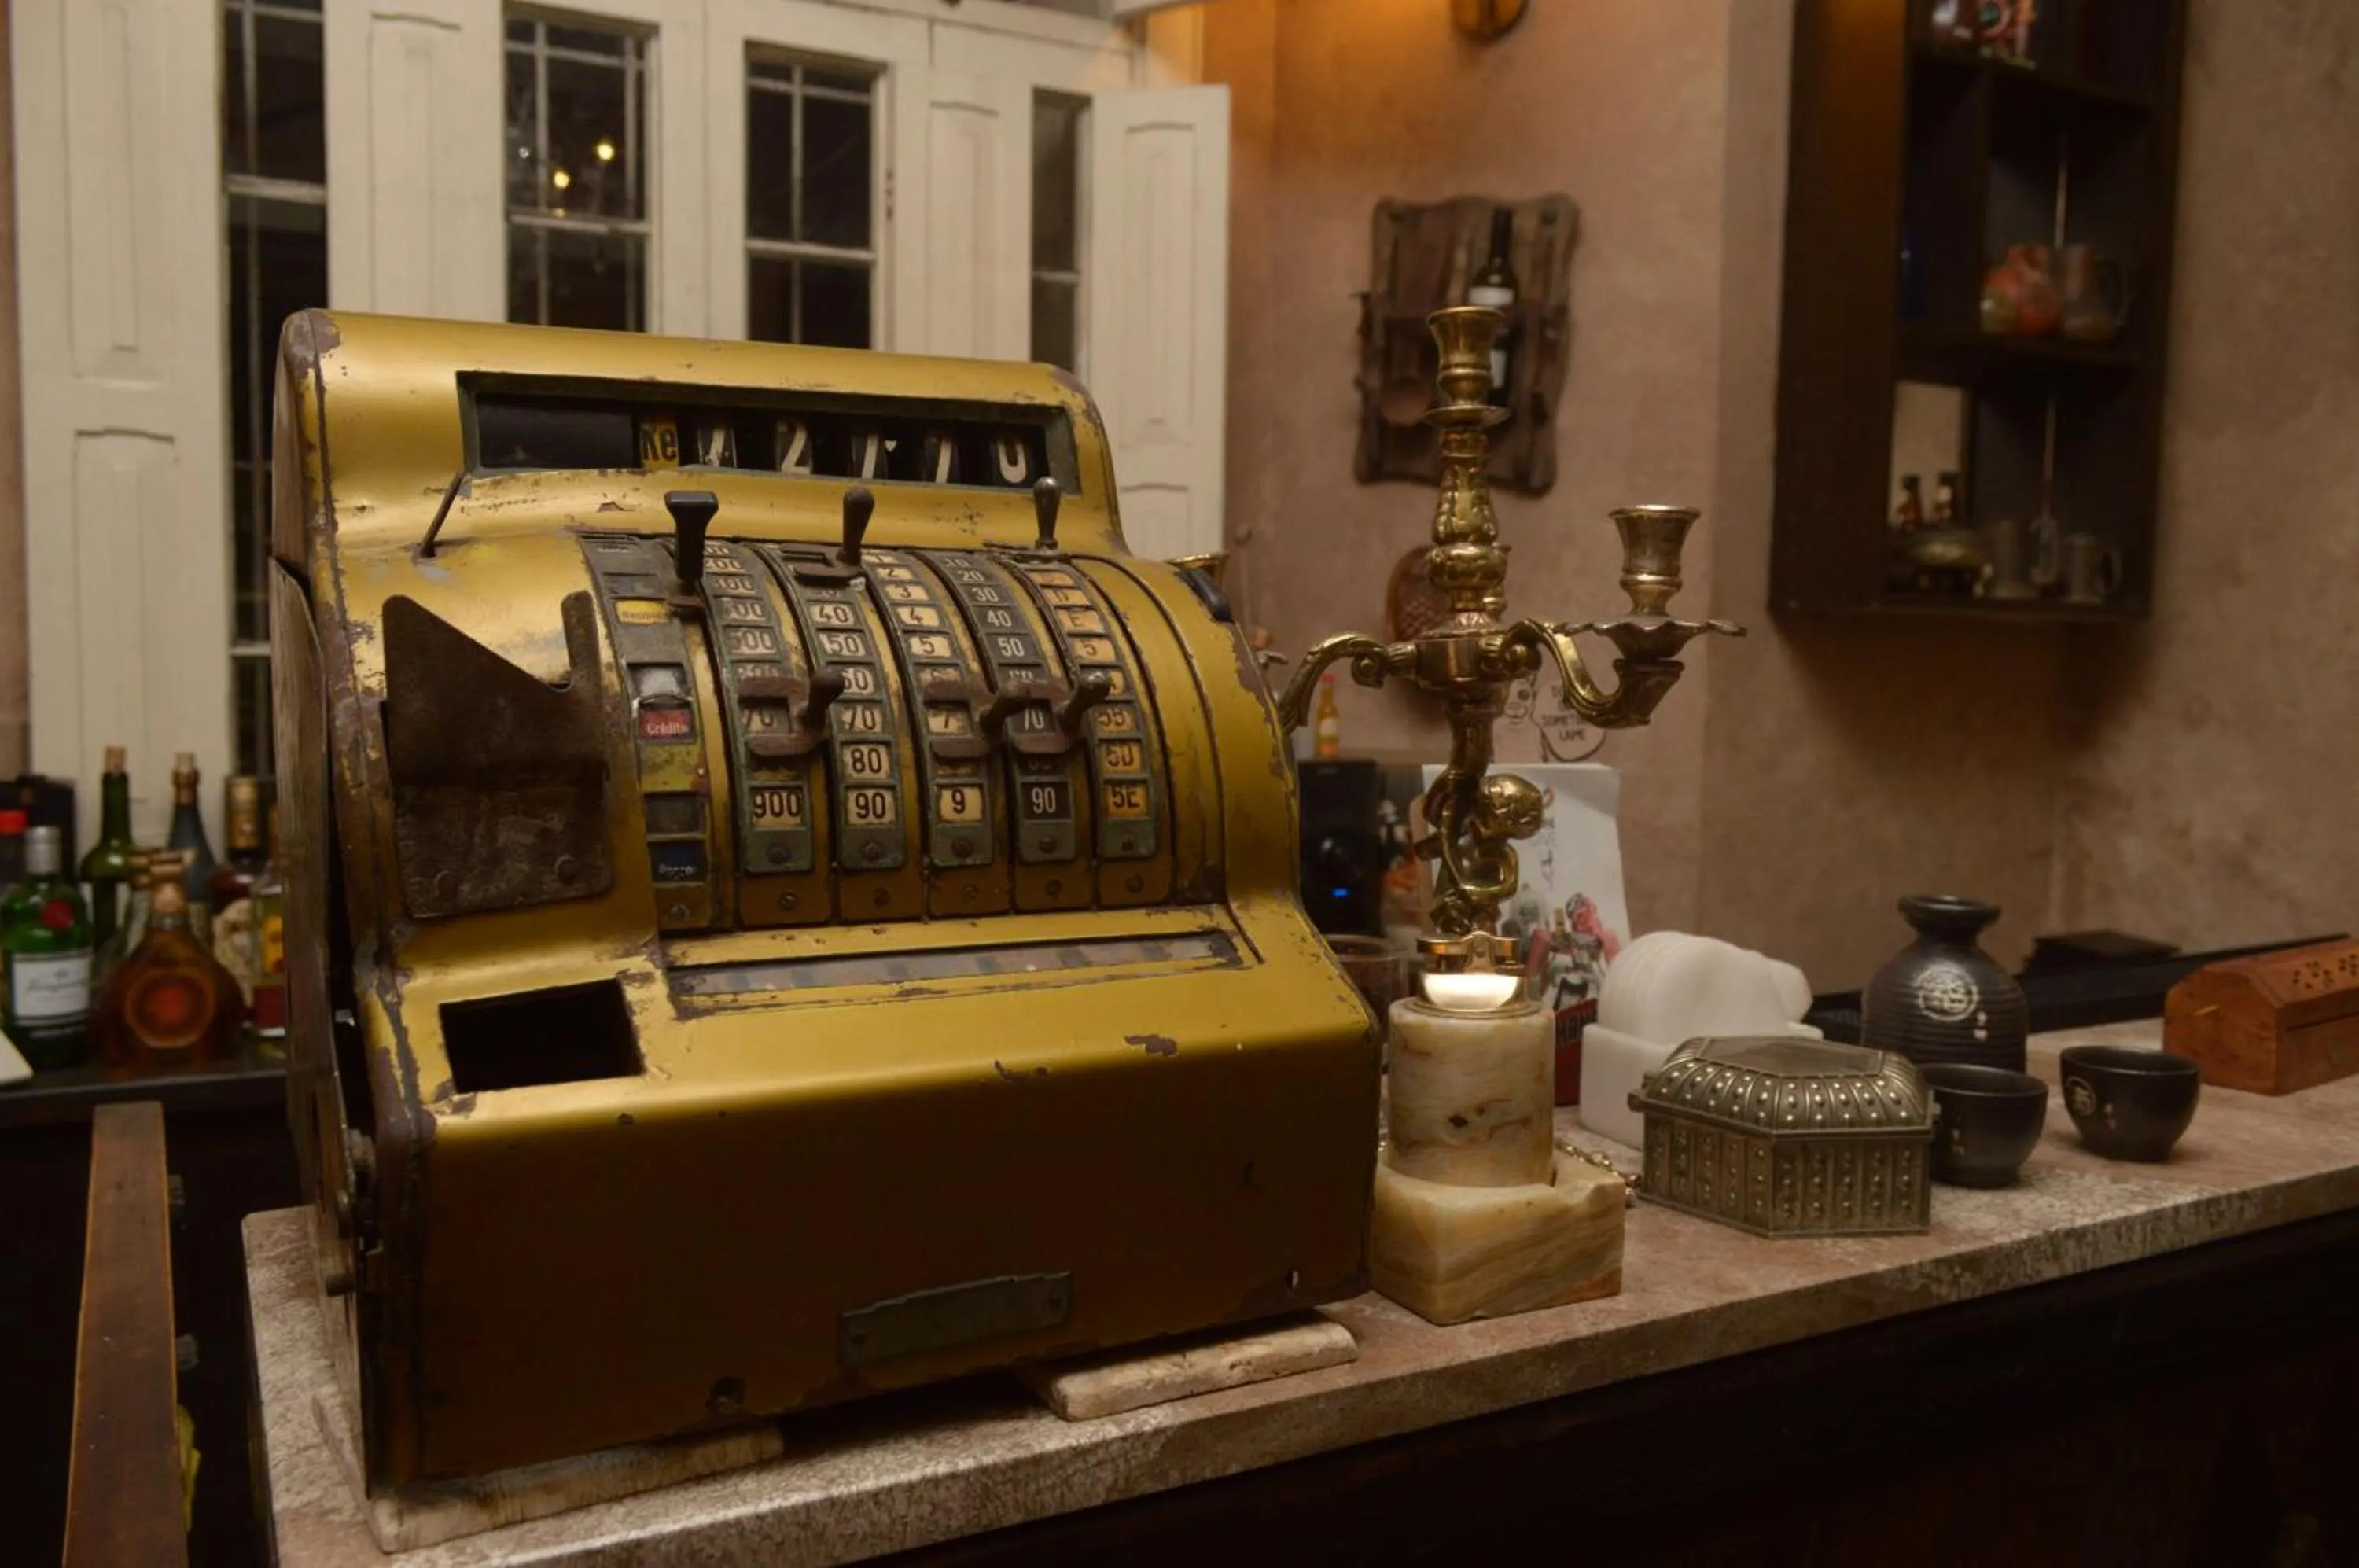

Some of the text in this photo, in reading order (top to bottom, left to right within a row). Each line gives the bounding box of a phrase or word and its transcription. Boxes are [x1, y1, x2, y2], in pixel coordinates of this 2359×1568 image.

[957, 570, 984, 582] 20
[972, 587, 999, 602] 30
[819, 605, 848, 624] 40
[909, 606, 923, 624] 4
[987, 609, 1012, 628] 40
[826, 635, 859, 654] 50
[918, 637, 936, 655] 5
[997, 637, 1025, 657] 50
[844, 706, 877, 731] 70
[851, 748, 881, 773] 80
[754, 792, 801, 818] 900
[855, 792, 886, 819] 90
[951, 789, 966, 815] 9
[1031, 787, 1056, 814] 90
